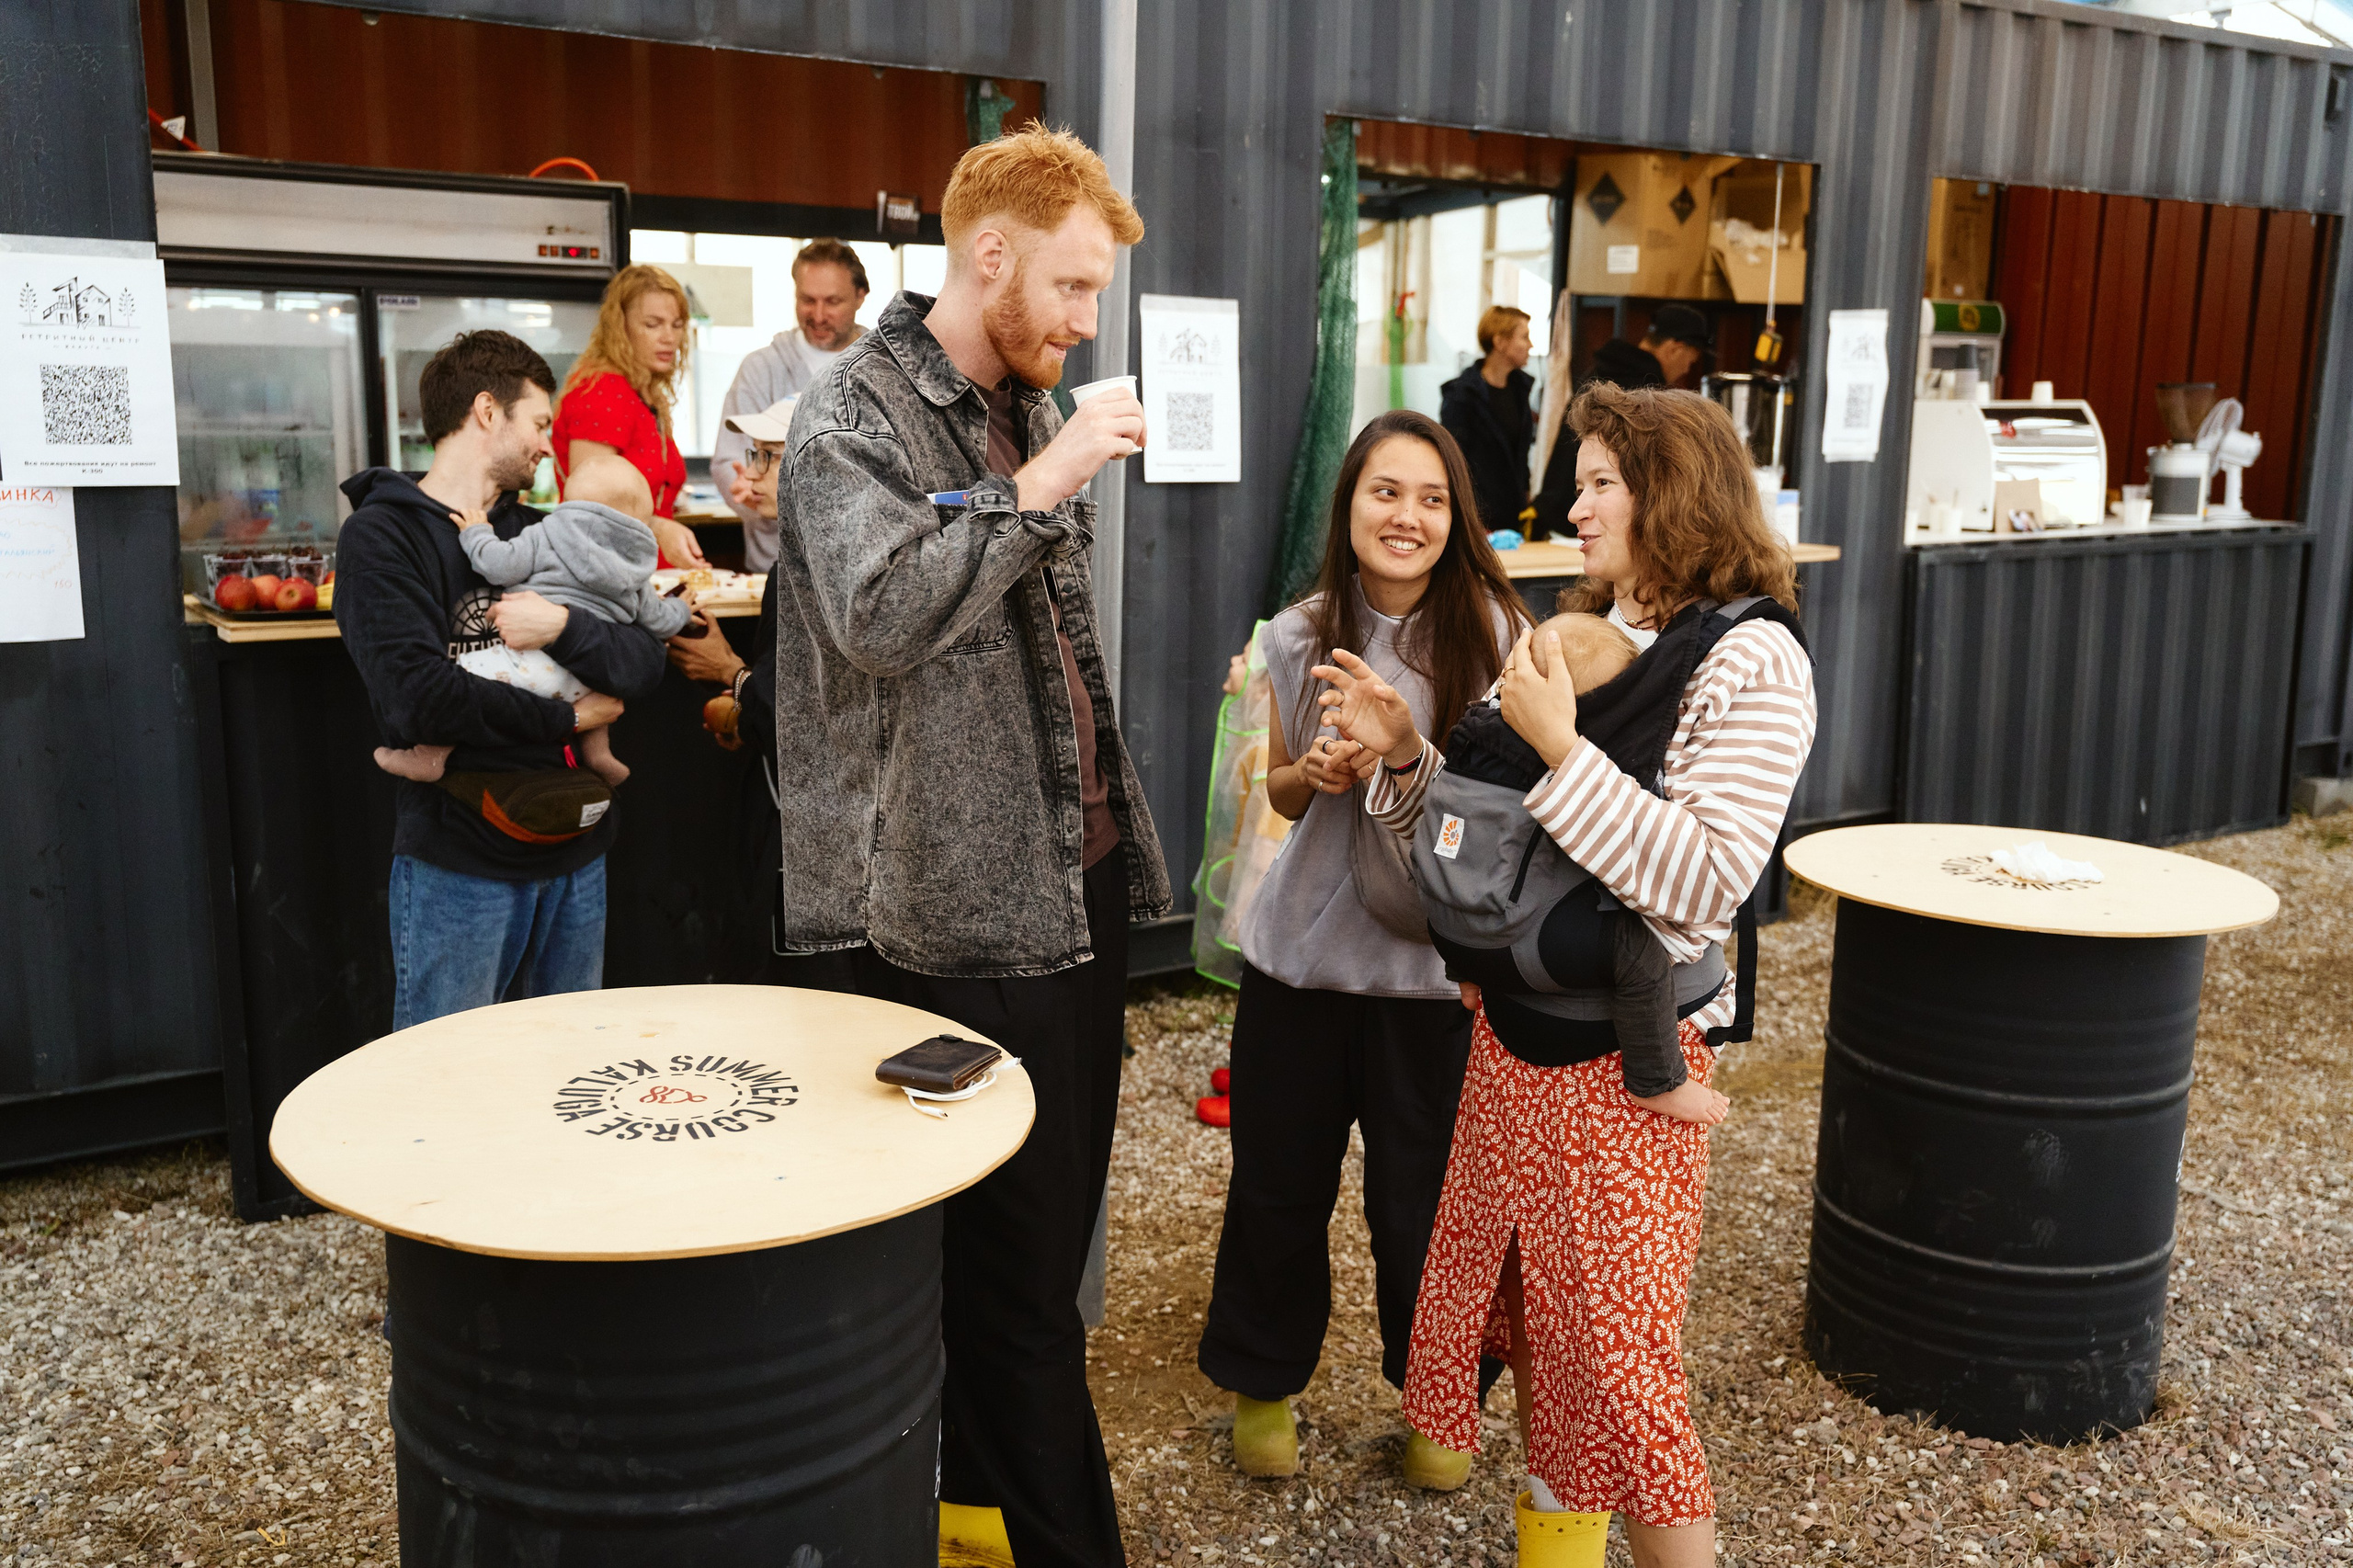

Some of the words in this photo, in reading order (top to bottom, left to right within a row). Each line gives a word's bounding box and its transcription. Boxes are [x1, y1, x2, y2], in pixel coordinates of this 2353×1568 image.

[0, 488, 53, 503] ИНКА
[552, 1059, 659, 1122] KALUGA
[669, 1055, 799, 1107] SUMMER
[585, 1108, 776, 1142] COURSE
